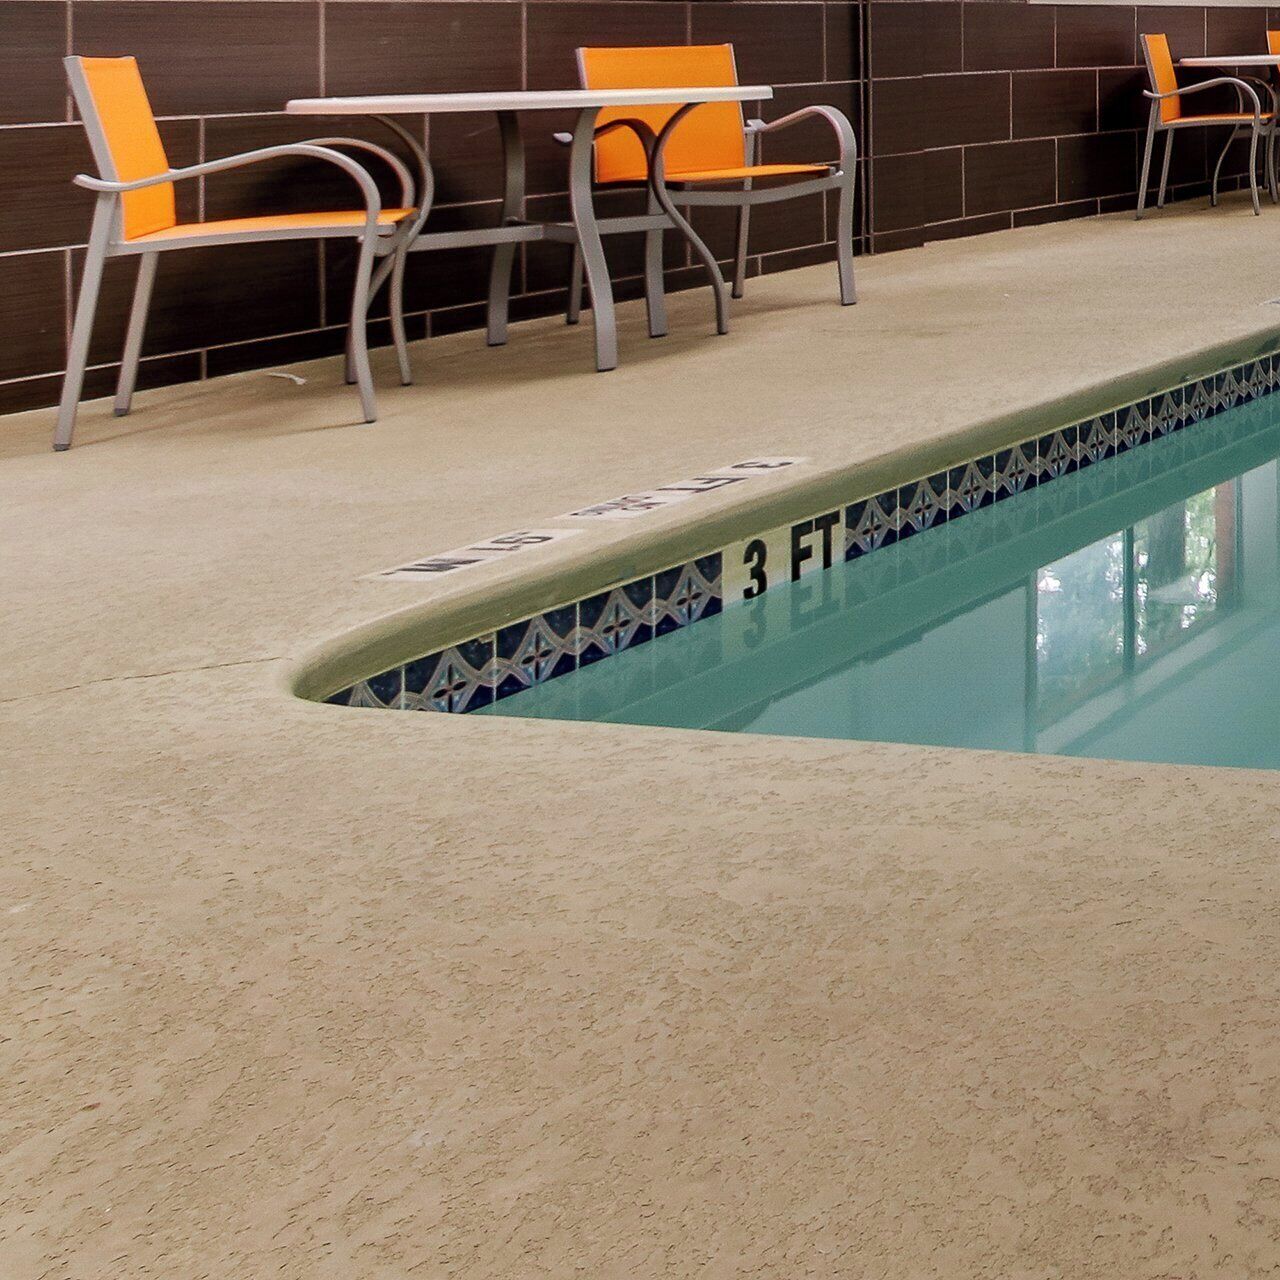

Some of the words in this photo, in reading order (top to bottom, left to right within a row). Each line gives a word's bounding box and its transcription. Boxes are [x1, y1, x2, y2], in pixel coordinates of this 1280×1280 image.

[657, 476, 748, 494] FT
[743, 538, 768, 600] 3
[790, 509, 840, 583] FT
